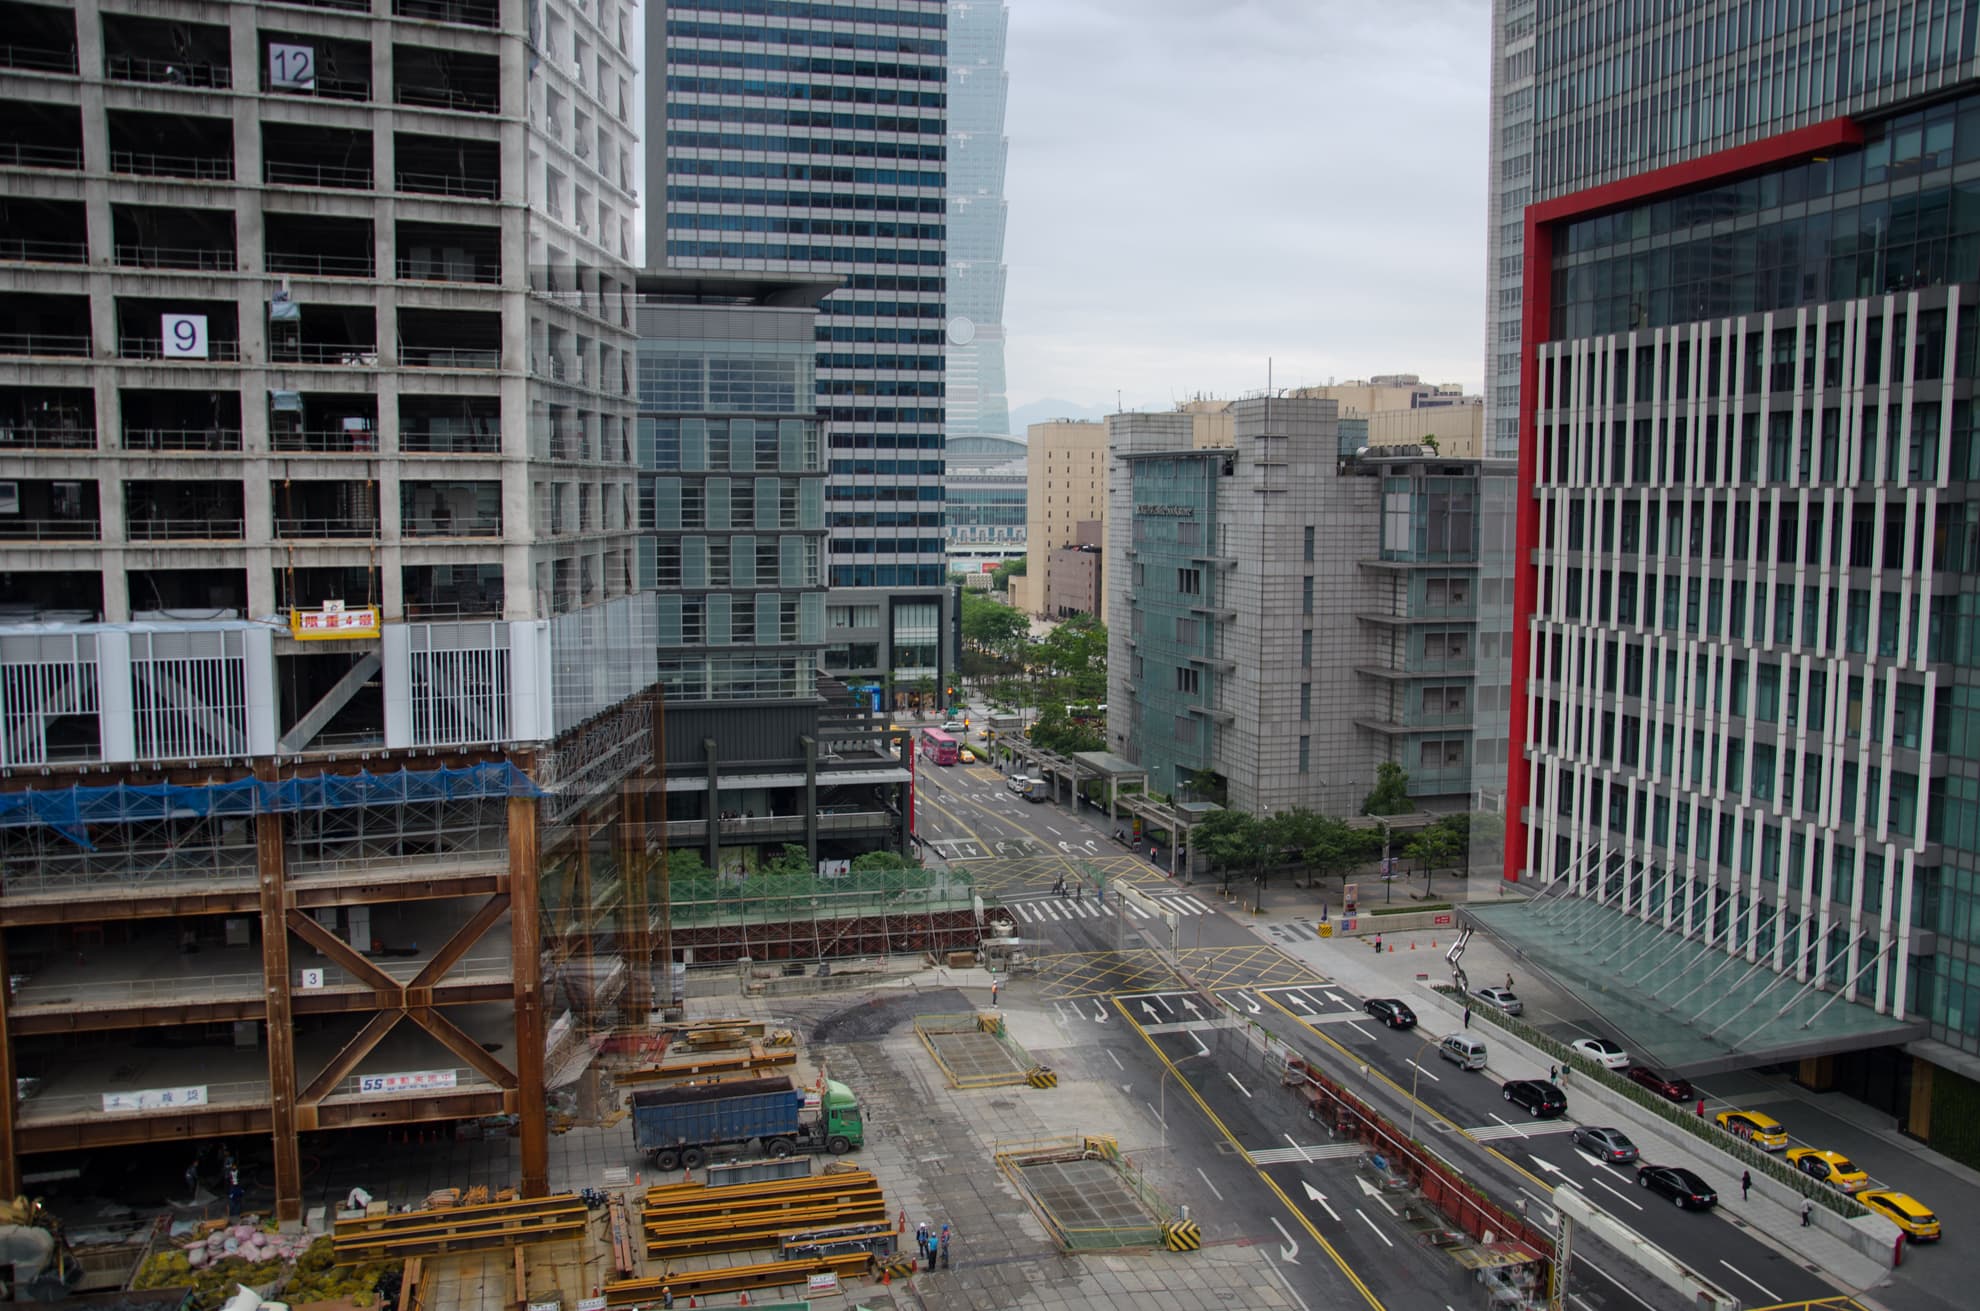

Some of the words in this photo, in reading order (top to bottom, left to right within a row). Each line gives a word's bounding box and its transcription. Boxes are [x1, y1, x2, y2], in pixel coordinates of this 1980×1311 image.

[274, 50, 309, 84] 12
[174, 319, 196, 351] 9
[309, 972, 317, 985] 3
